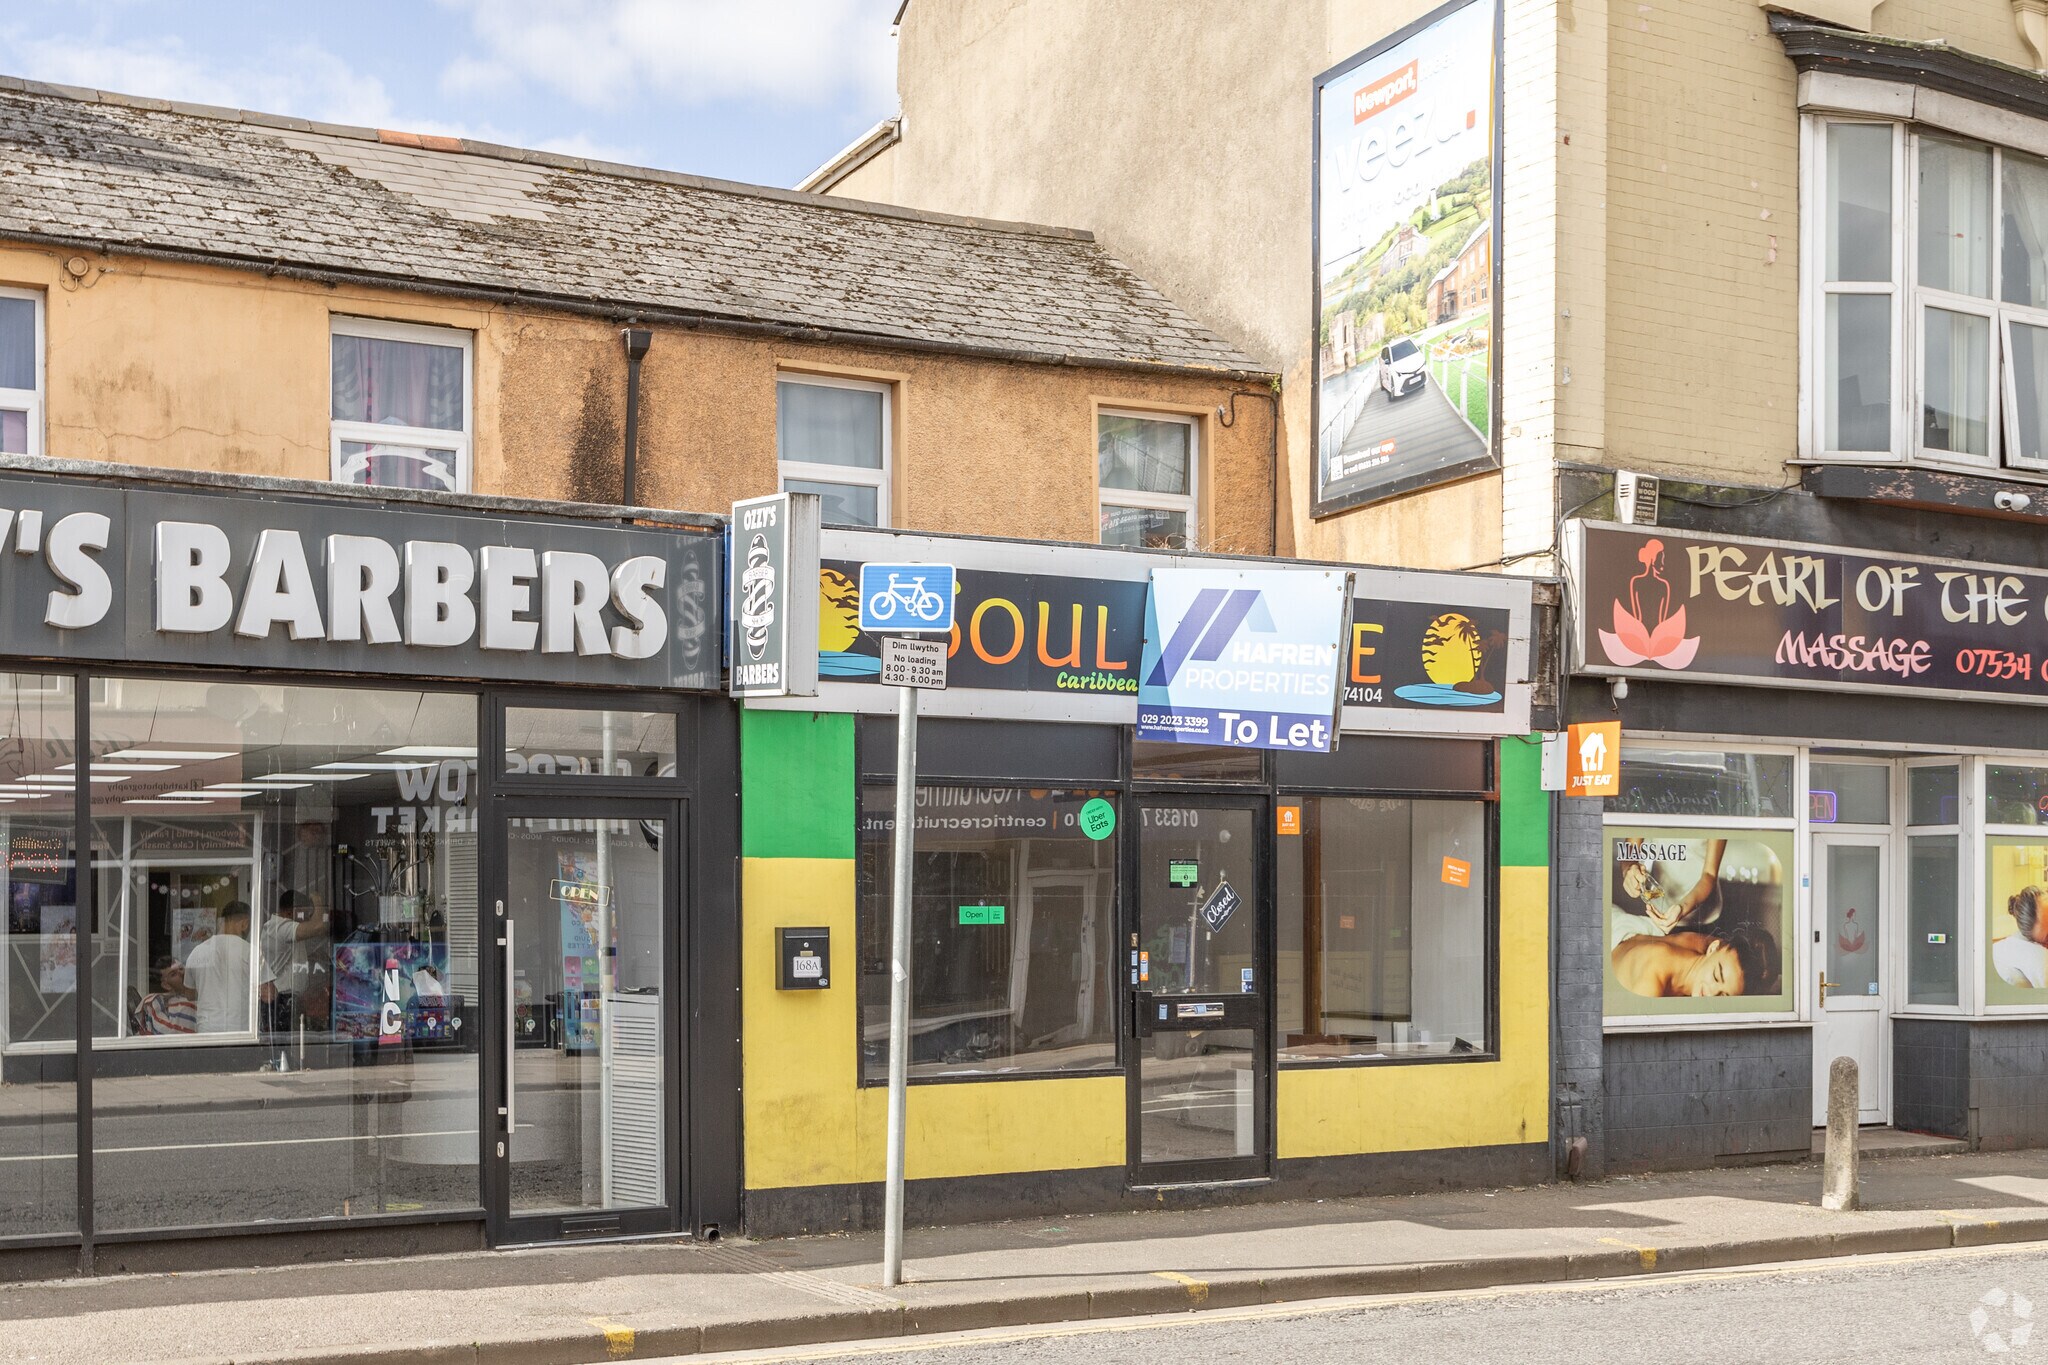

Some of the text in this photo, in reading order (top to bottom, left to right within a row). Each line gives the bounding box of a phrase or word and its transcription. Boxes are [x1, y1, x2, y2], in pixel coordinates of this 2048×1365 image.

[743, 505, 777, 531] OZZY'S
[155, 520, 667, 659] BARBERS
[1685, 545, 1839, 614] PEARL
[1855, 564, 1922, 616] OF
[1935, 571, 2029, 626] THE
[892, 641, 939, 653] Dim llwytho
[1232, 640, 1333, 666] HAFREN
[1775, 629, 1932, 677] MASSAGE
[886, 664, 905, 672] 8.00
[911, 666, 930, 675] 9.30
[894, 654, 936, 666] No loading
[1955, 648, 2032, 681] 07534
[736, 663, 779, 685] BARBERS
[885, 673, 904, 682] 4.30
[911, 675, 930, 683] 6.00
[1056, 671, 1139, 692] Caribbea
[1185, 667, 1330, 696] PROPERTIES
[1141, 713, 1208, 727] 029 2023 3399
[1218, 712, 1326, 748] To Let
[1572, 774, 1613, 788] JUST EAT
[1809, 793, 1833, 820] PEN
[1087, 812, 1105, 824] Uber
[1090, 820, 1109, 832] Eats
[1616, 842, 1687, 862] MASSAGE
[561, 885, 599, 901] OPEN
[965, 910, 983, 920] Open
[1206, 887, 1235, 924] Closed
[796, 960, 818, 970] 168A
